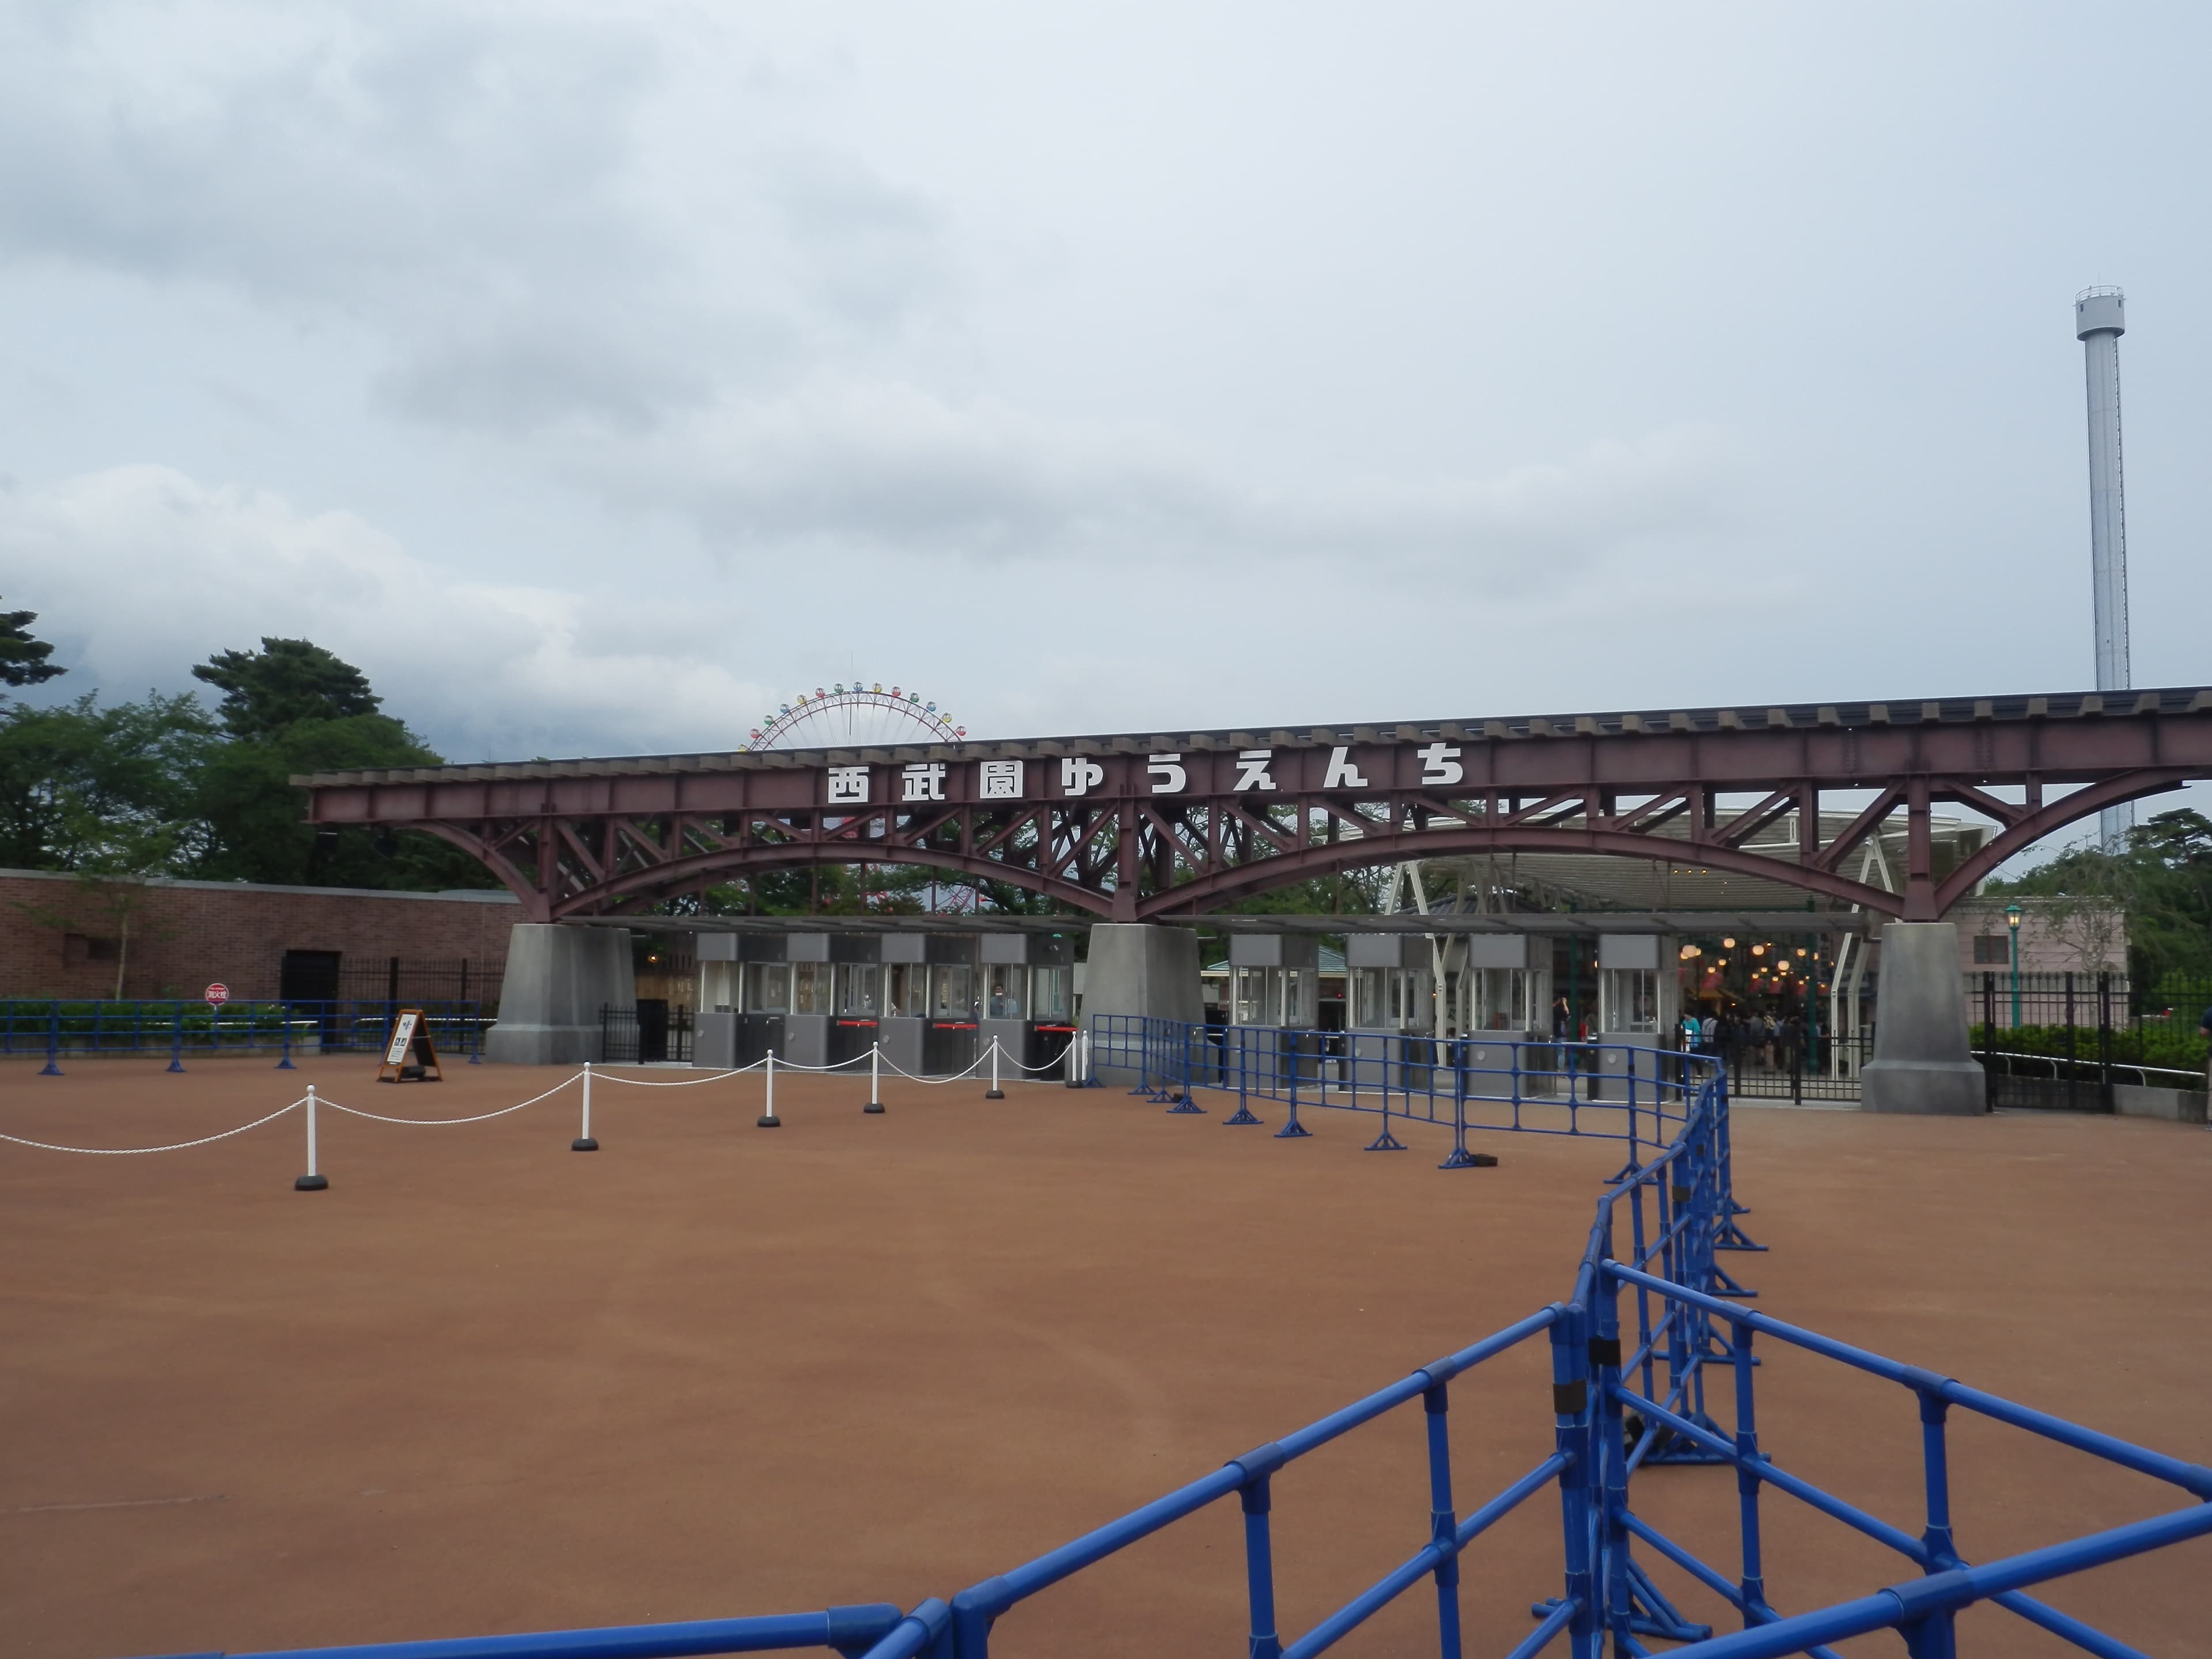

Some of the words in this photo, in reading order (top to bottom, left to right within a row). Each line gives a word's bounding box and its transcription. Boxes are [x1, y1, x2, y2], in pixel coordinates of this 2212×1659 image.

[828, 743, 1463, 804] 西武園ゆうえんち
